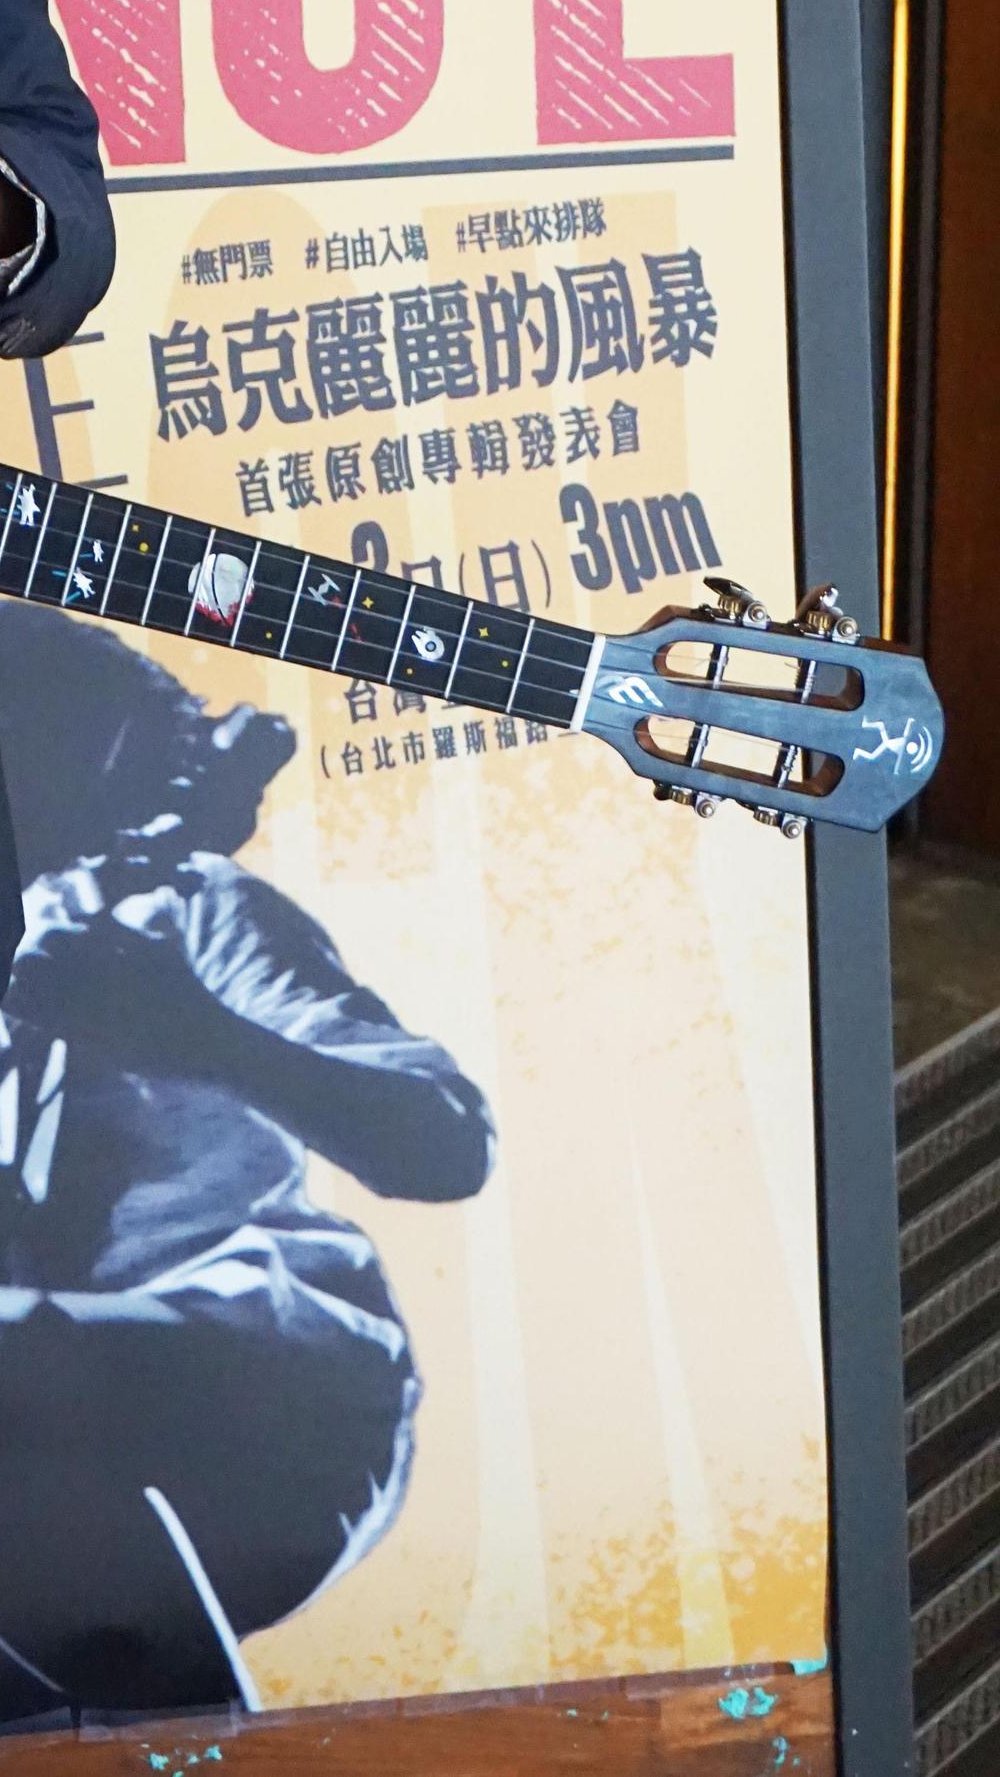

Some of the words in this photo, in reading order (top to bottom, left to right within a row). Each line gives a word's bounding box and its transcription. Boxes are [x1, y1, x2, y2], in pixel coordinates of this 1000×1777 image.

[305, 223, 429, 274] #自由入場
[455, 197, 608, 253] #早點來排隊
[148, 246, 719, 442] 烏克麗麗的風暴
[235, 398, 641, 517] 首張原創專輯發表會
[558, 482, 723, 595] 3pm
[320, 716, 580, 778] (台北市羅斯福路
